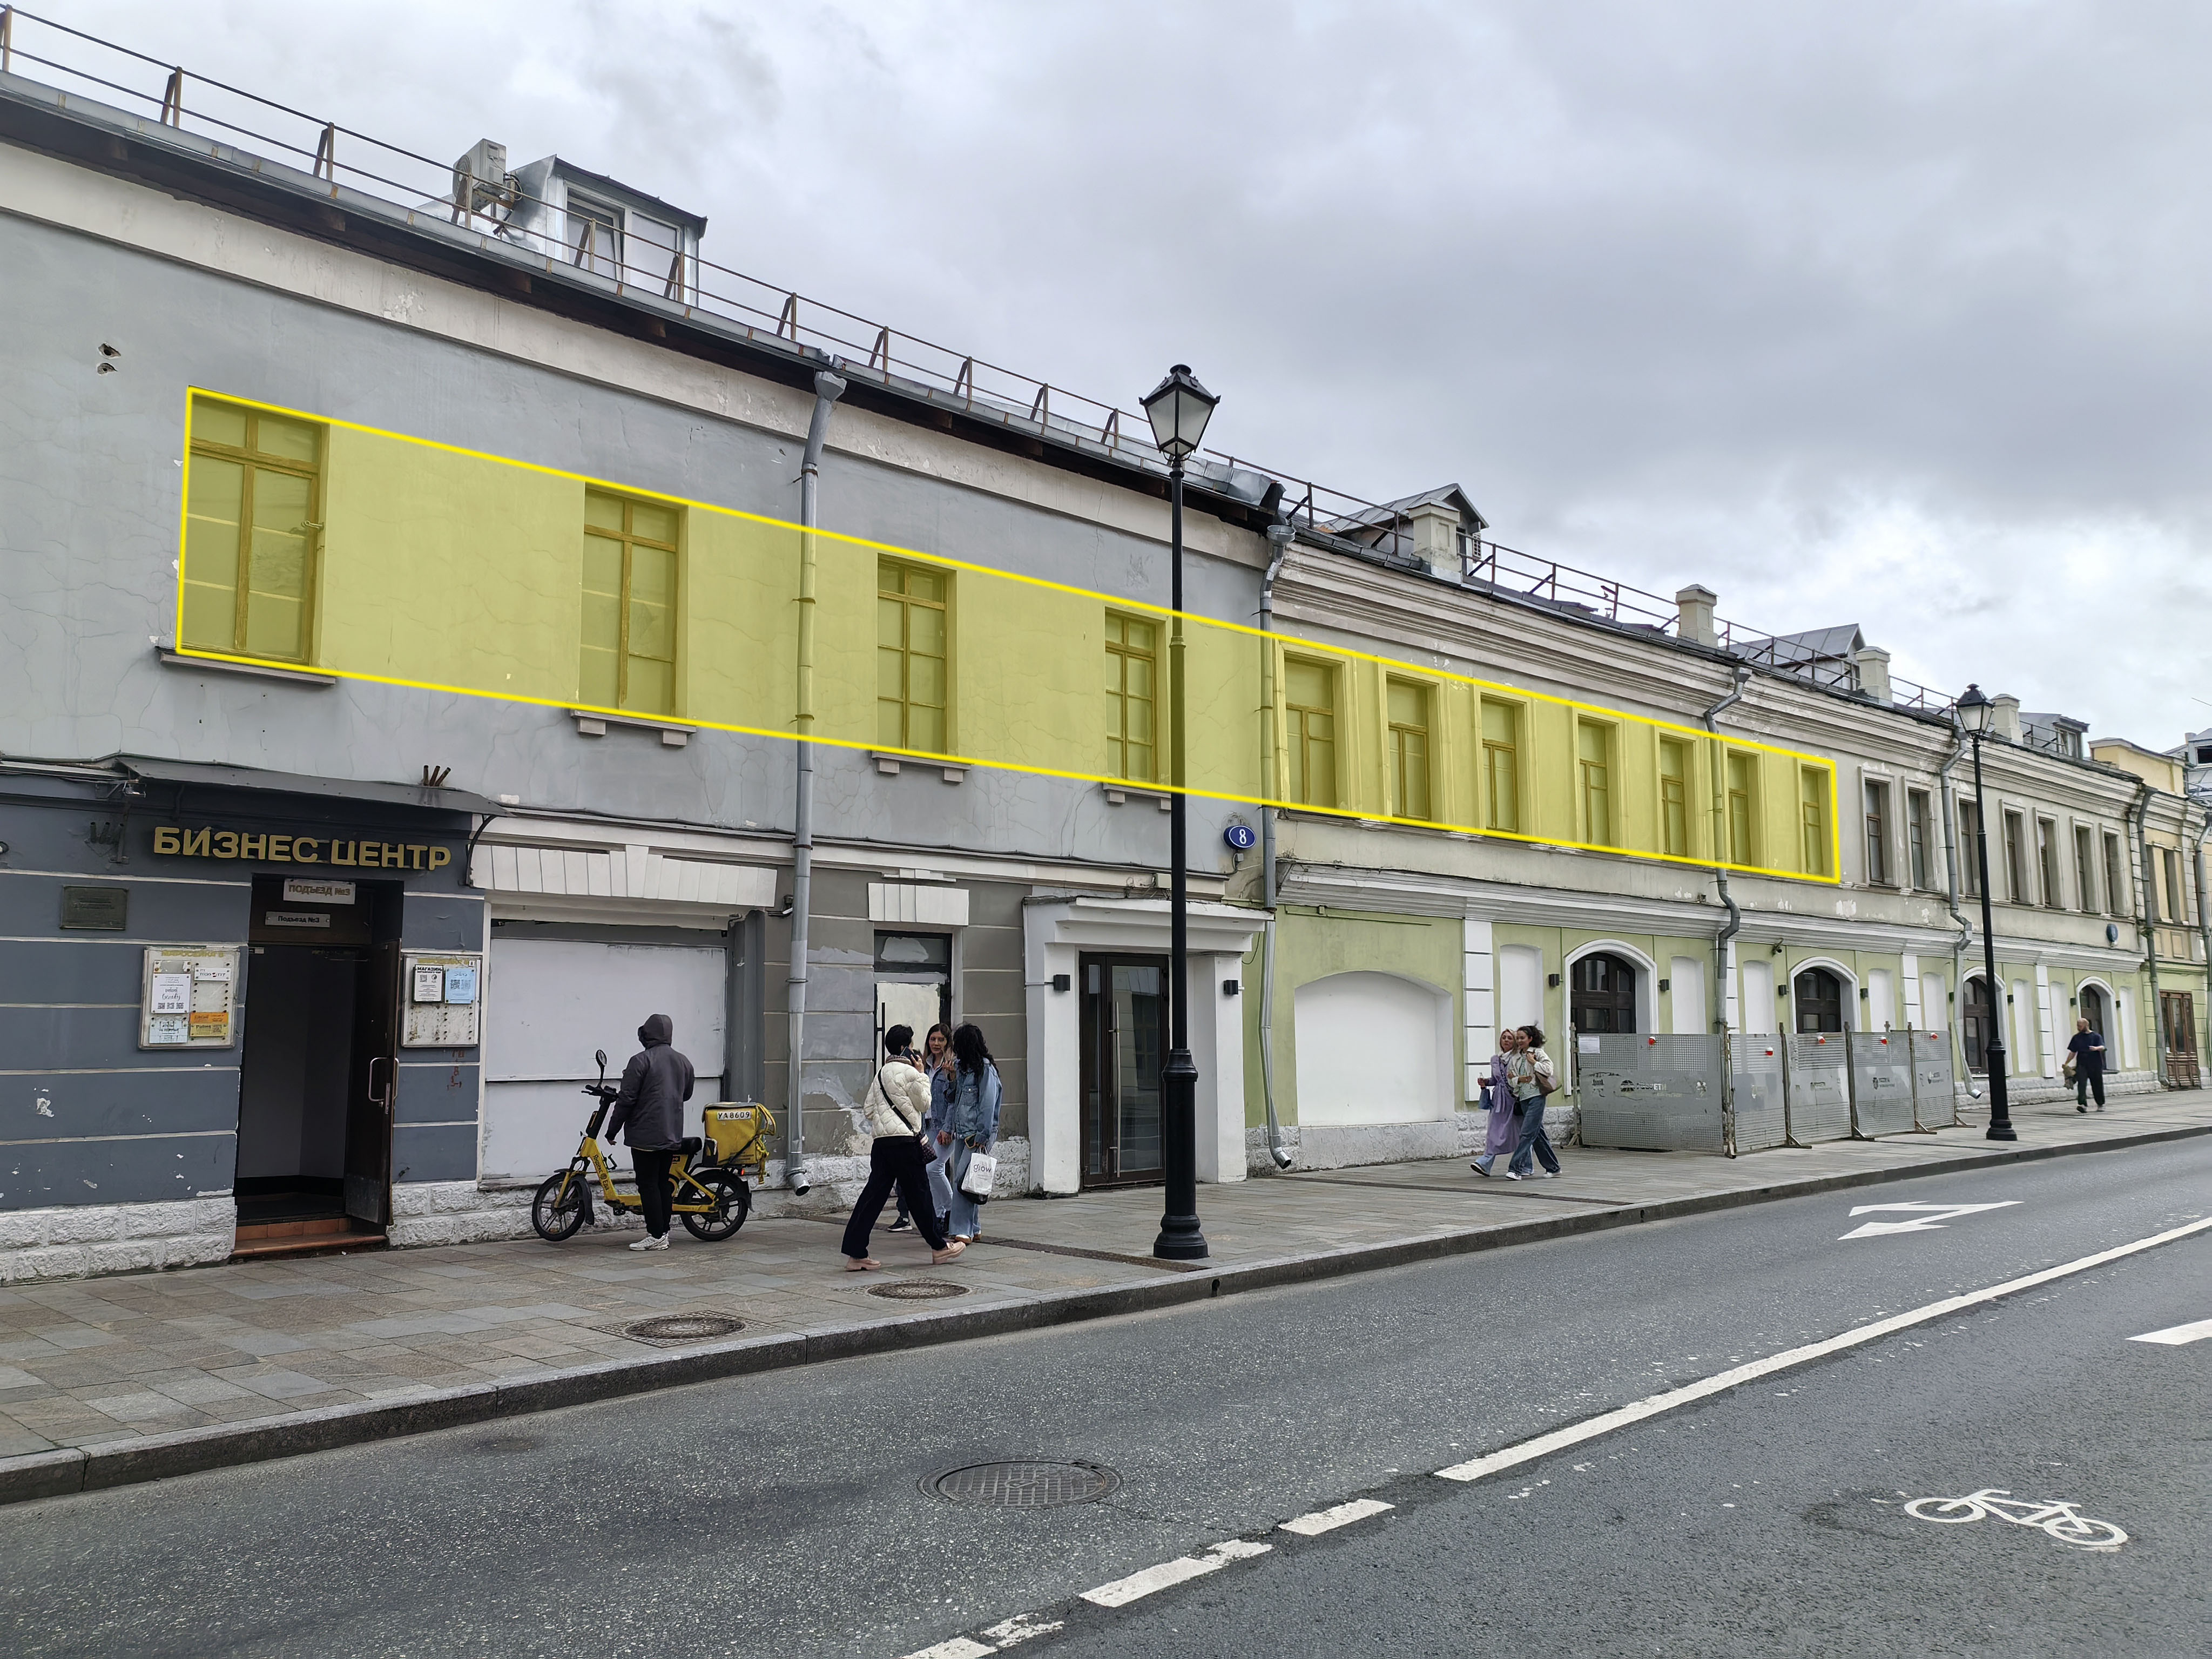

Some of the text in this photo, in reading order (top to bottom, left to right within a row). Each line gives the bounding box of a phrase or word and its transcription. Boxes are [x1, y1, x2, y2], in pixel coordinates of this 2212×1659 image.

[1239, 829, 1247, 844] 8
[154, 826, 451, 871] БИЗНЕС ЦЕНТР
[288, 885, 350, 896] ПОДЪЕЗД №3
[973, 1164, 992, 1173] glow
